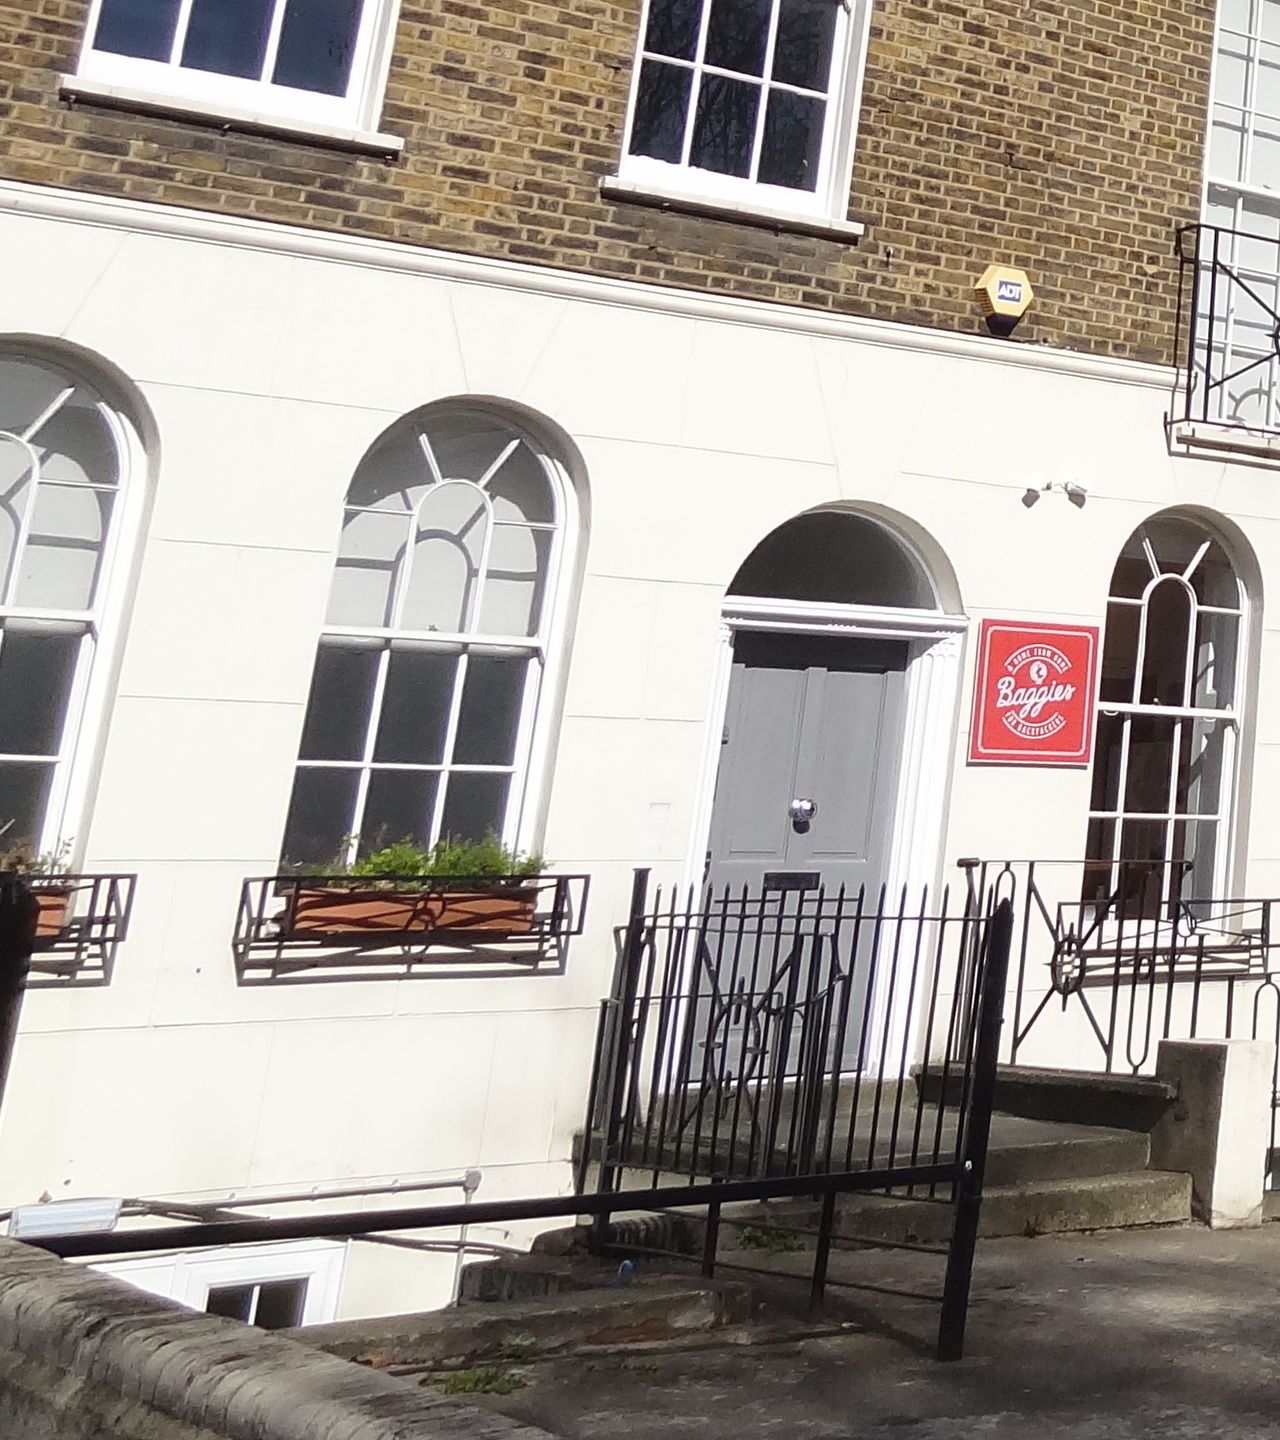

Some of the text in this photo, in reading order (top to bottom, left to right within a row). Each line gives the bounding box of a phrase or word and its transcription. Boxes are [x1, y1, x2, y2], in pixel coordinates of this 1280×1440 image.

[999, 283, 1021, 300] ADT
[996, 676, 1076, 718] Baggies
[1017, 714, 1065, 736] BACKPACKERS
